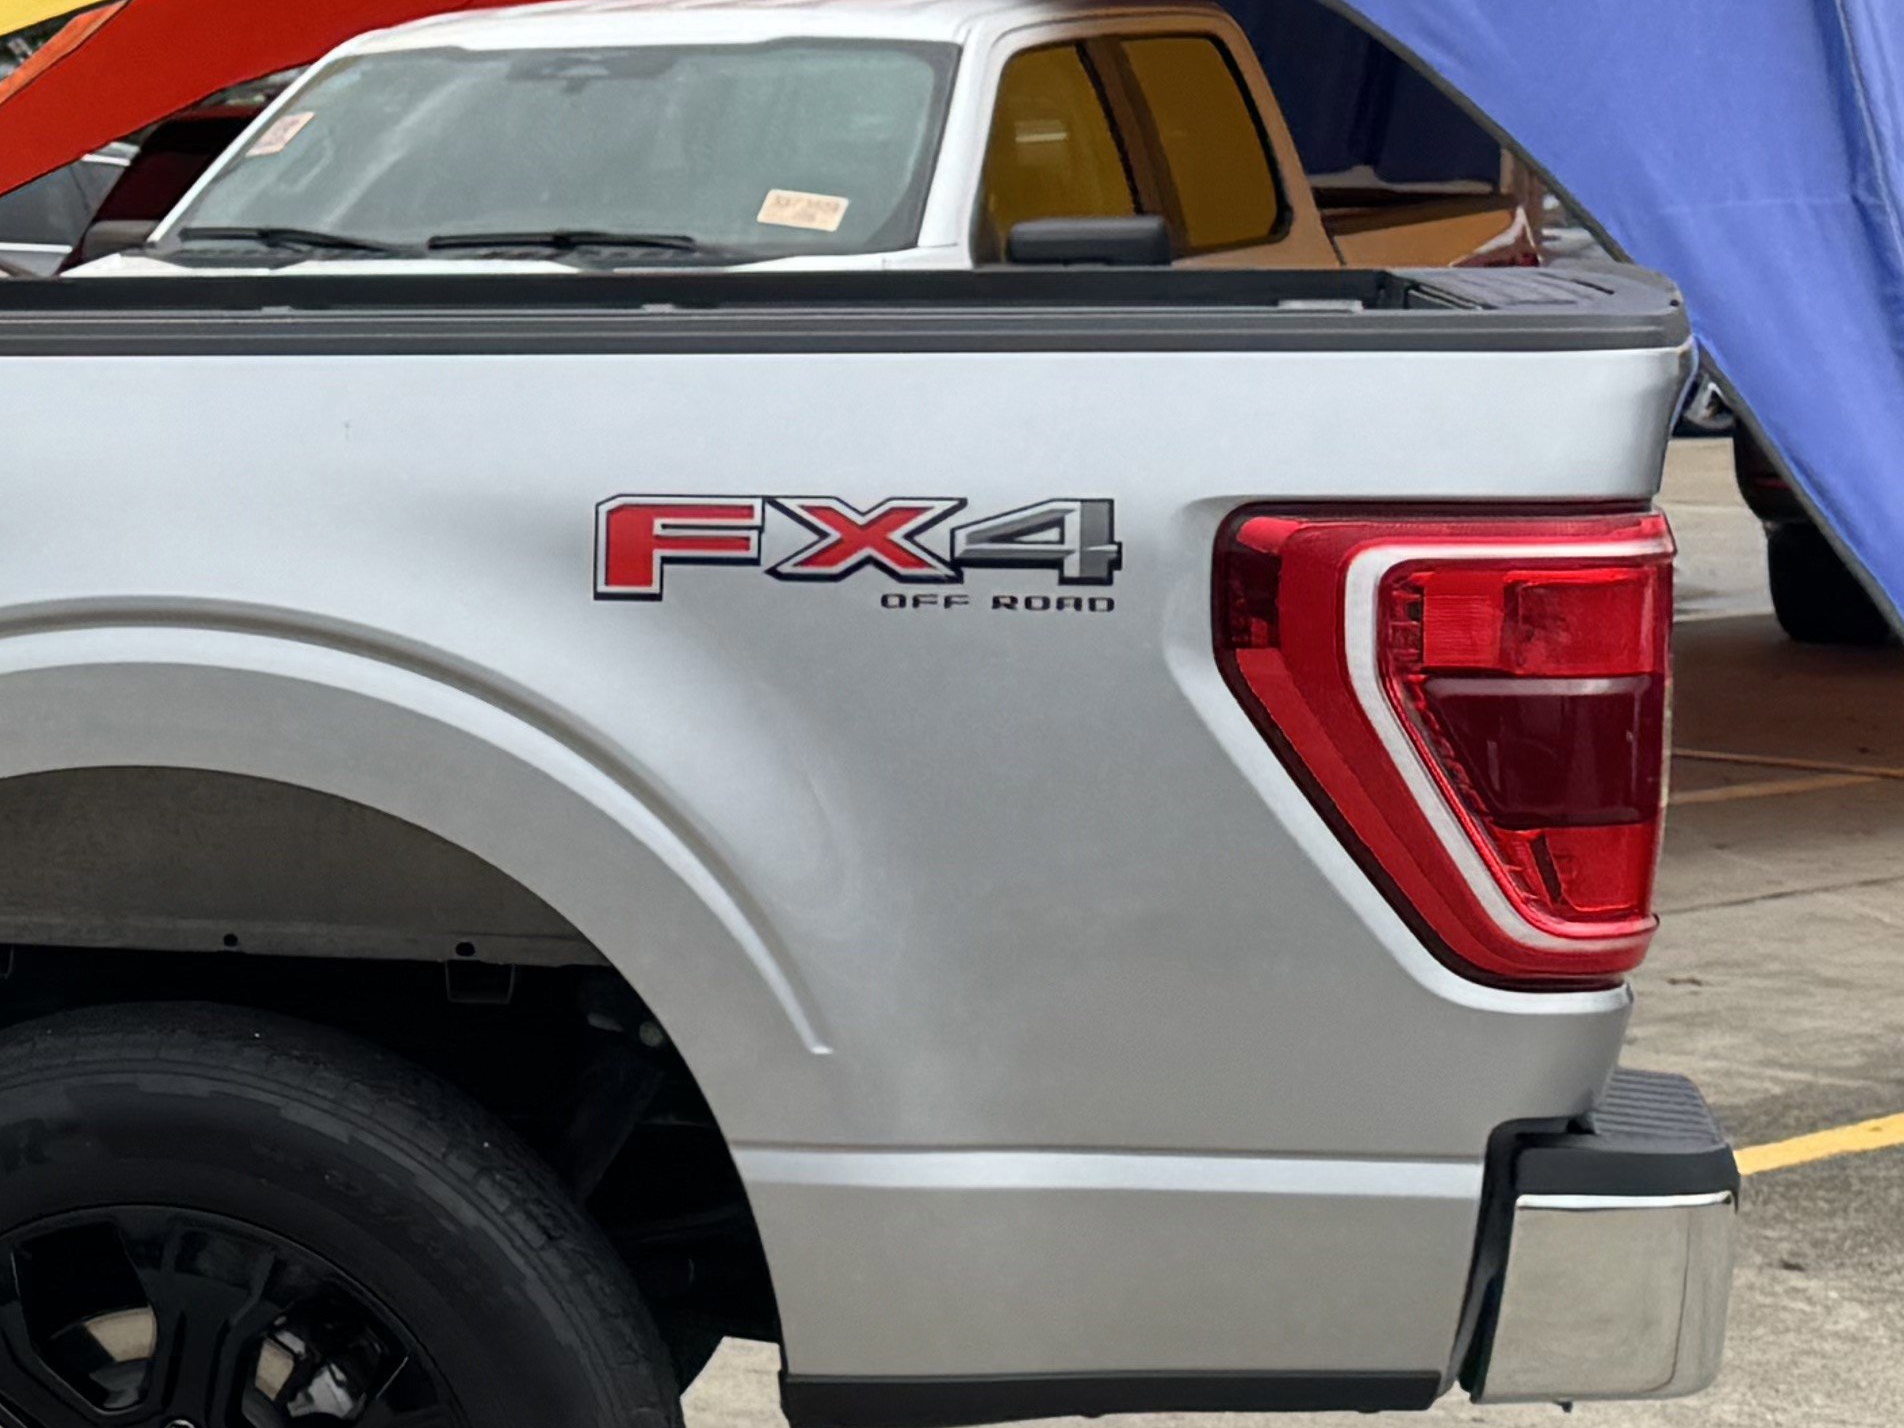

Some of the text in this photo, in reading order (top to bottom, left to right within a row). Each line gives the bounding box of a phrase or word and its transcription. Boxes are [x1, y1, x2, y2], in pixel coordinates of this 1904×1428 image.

[593, 494, 1122, 600] FX4
[880, 593, 1115, 613] OFF ROAD
